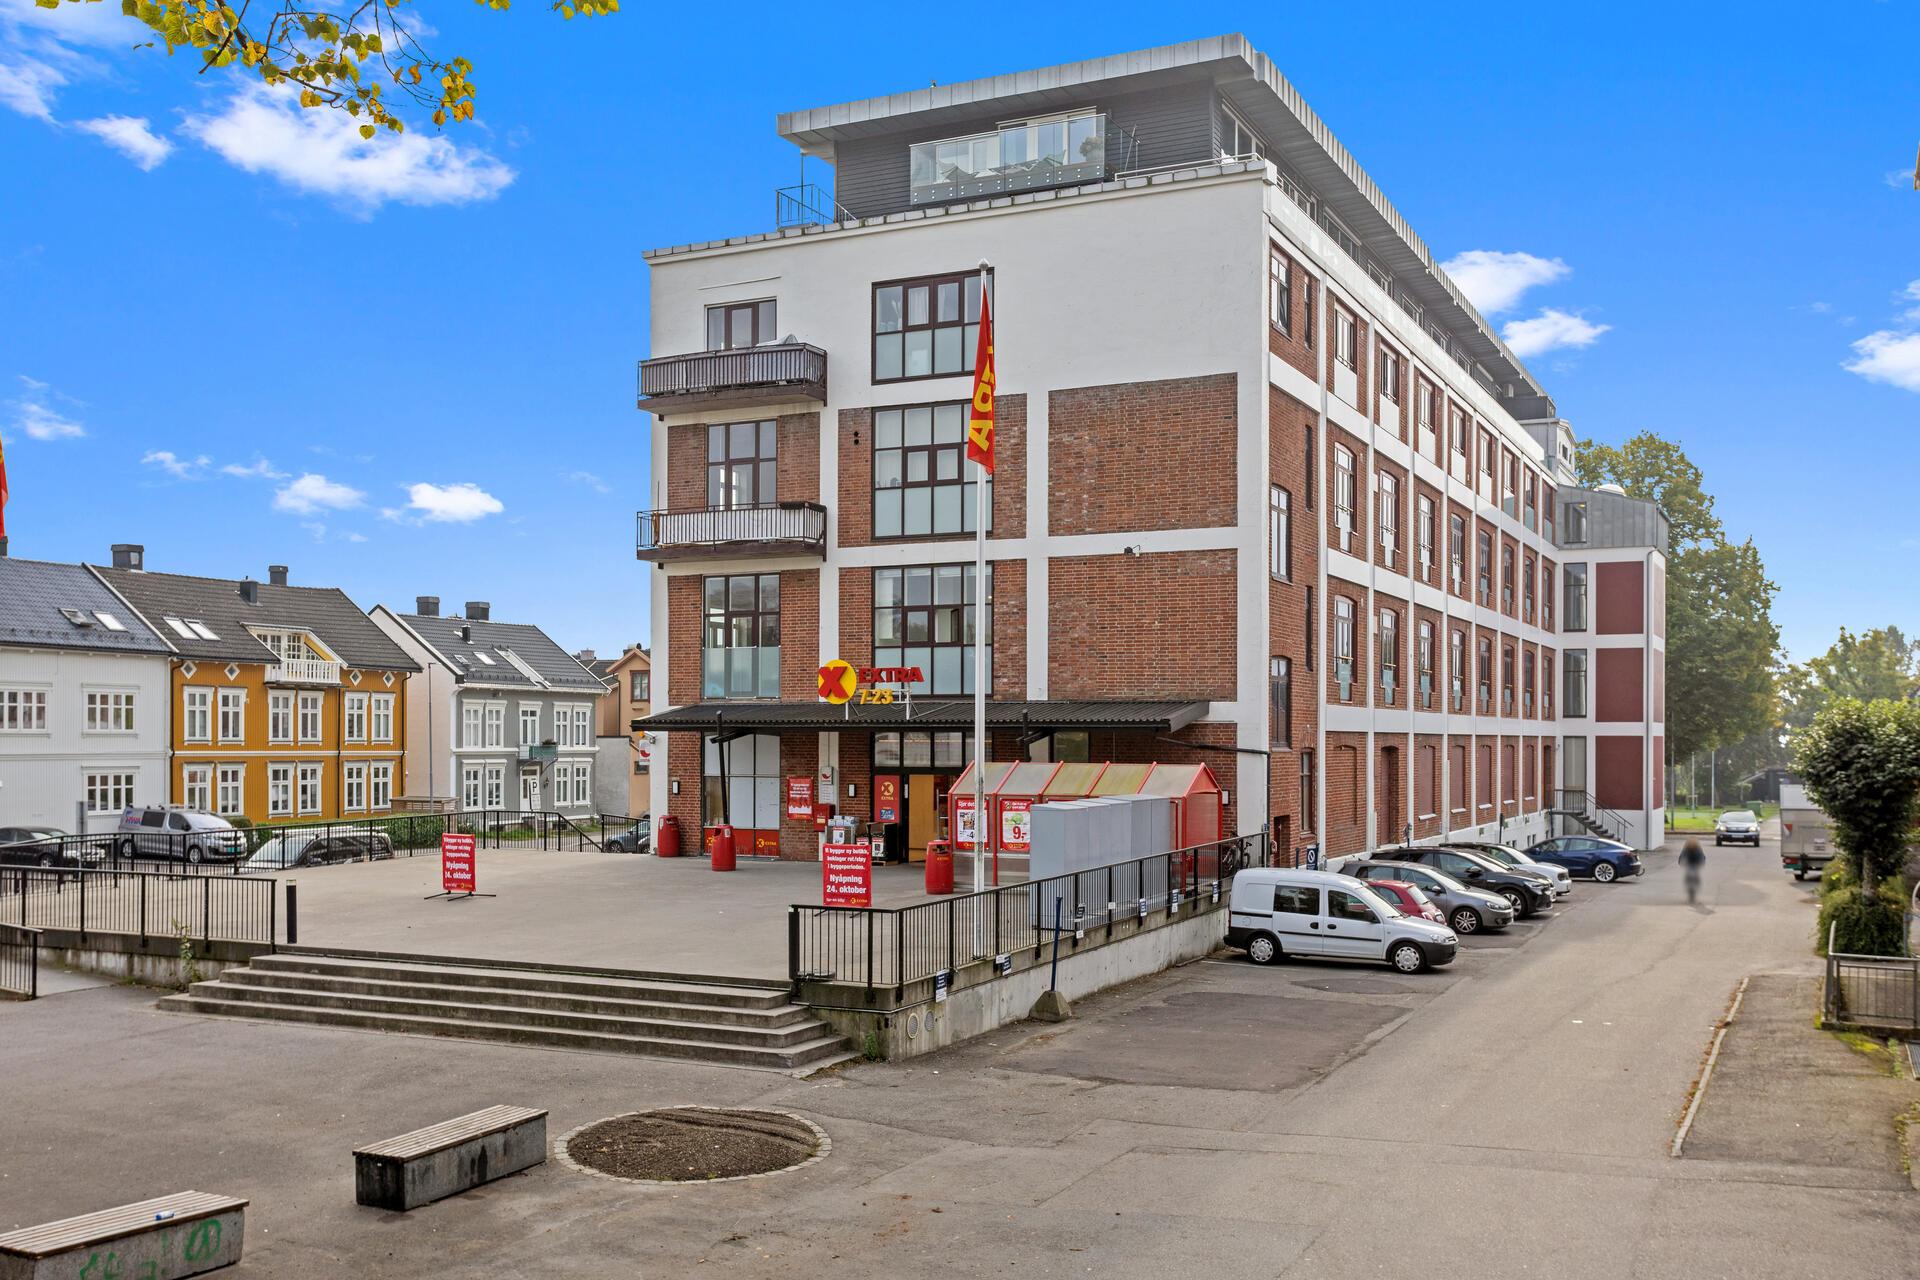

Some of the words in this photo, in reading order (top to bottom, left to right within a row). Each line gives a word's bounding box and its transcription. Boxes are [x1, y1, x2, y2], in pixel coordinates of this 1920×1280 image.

[859, 667, 924, 683] EXTRA
[860, 689, 893, 704] 7-23
[453, 871, 471, 879] oktober
[830, 874, 863, 884] Nyåpning
[826, 885, 838, 893] 24.
[840, 885, 866, 893] oktober
